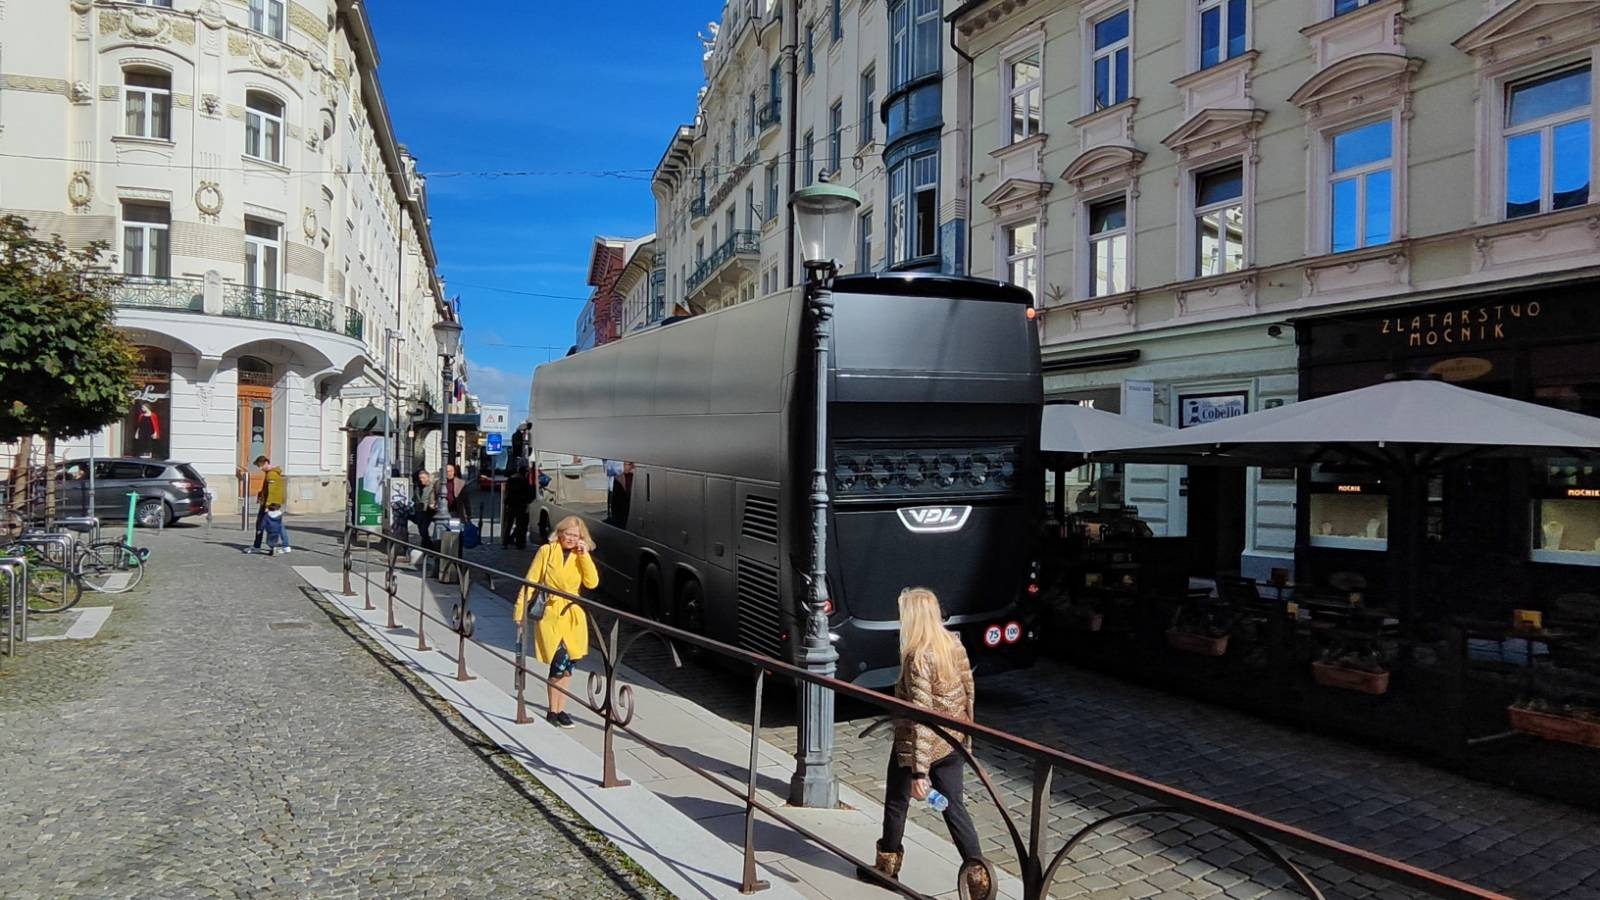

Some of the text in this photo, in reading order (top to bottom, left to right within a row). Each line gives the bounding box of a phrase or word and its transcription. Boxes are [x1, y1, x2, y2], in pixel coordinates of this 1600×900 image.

[1202, 403, 1241, 420] Cobello
[908, 508, 958, 524] VDL
[988, 629, 1000, 640] 75
[1007, 627, 1019, 636] 100
